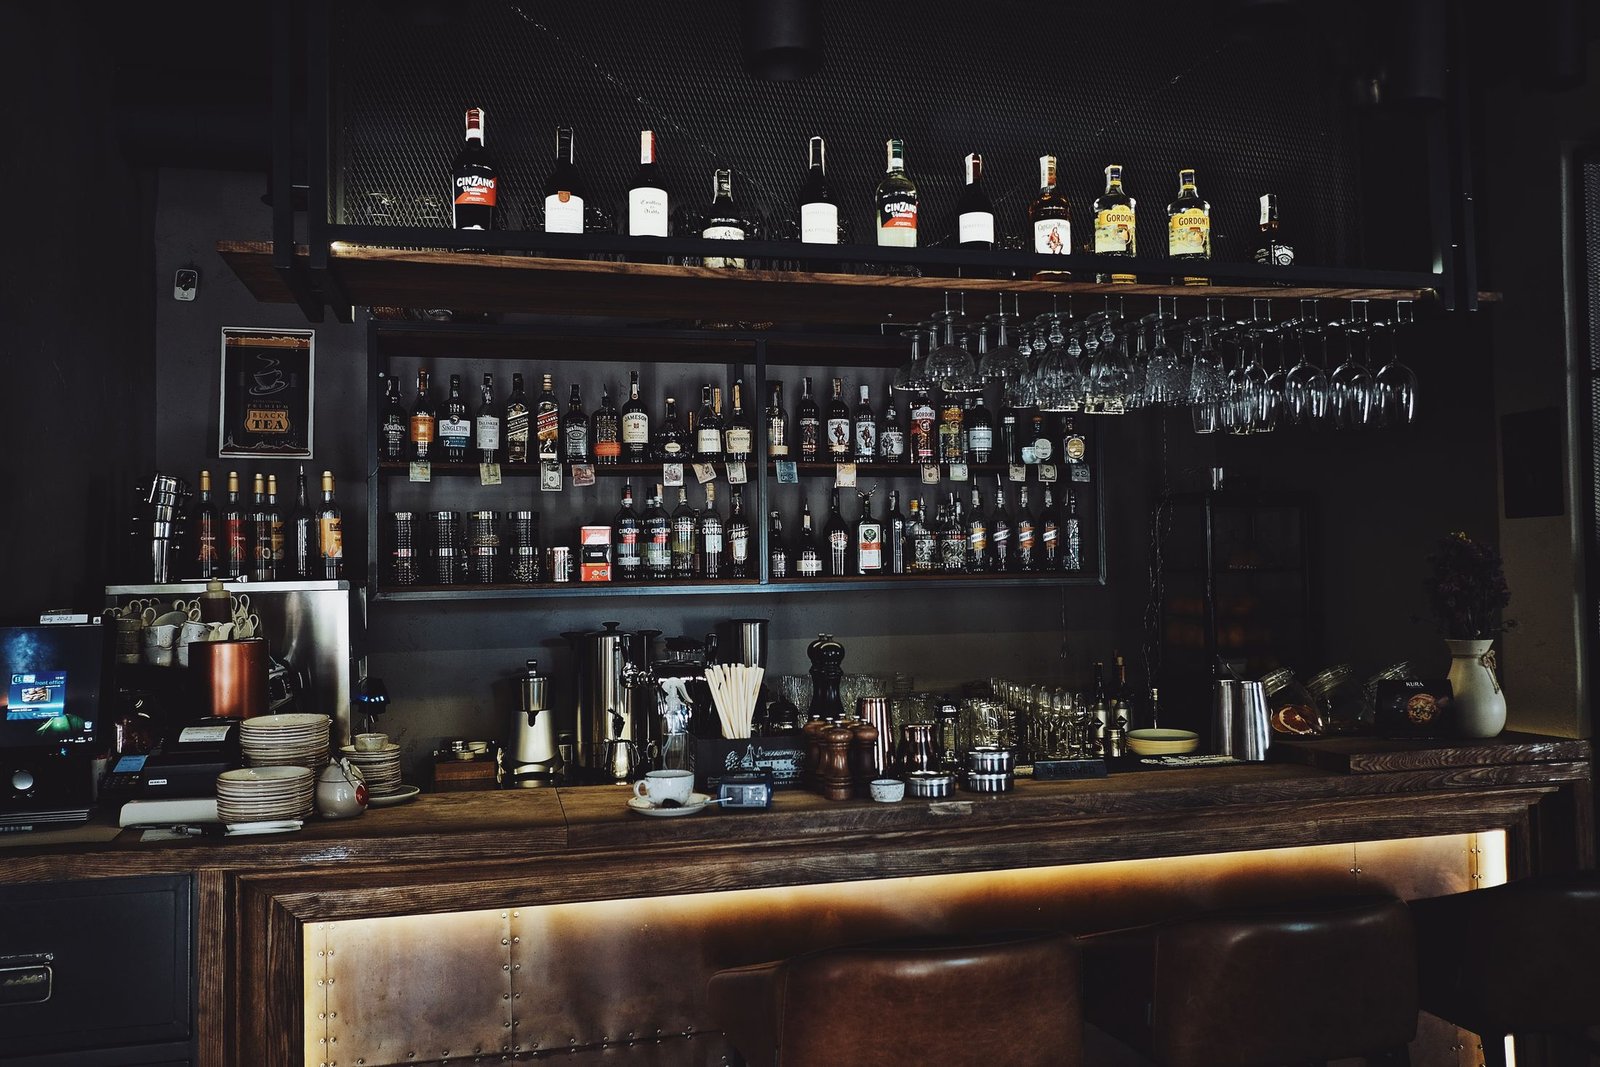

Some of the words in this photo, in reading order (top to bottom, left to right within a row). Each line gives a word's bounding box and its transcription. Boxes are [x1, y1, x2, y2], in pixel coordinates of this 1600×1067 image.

[457, 175, 494, 188] CINZANO
[623, 413, 648, 423] JAMESON
[252, 419, 284, 430] TEA
[443, 439, 451, 447] 12
